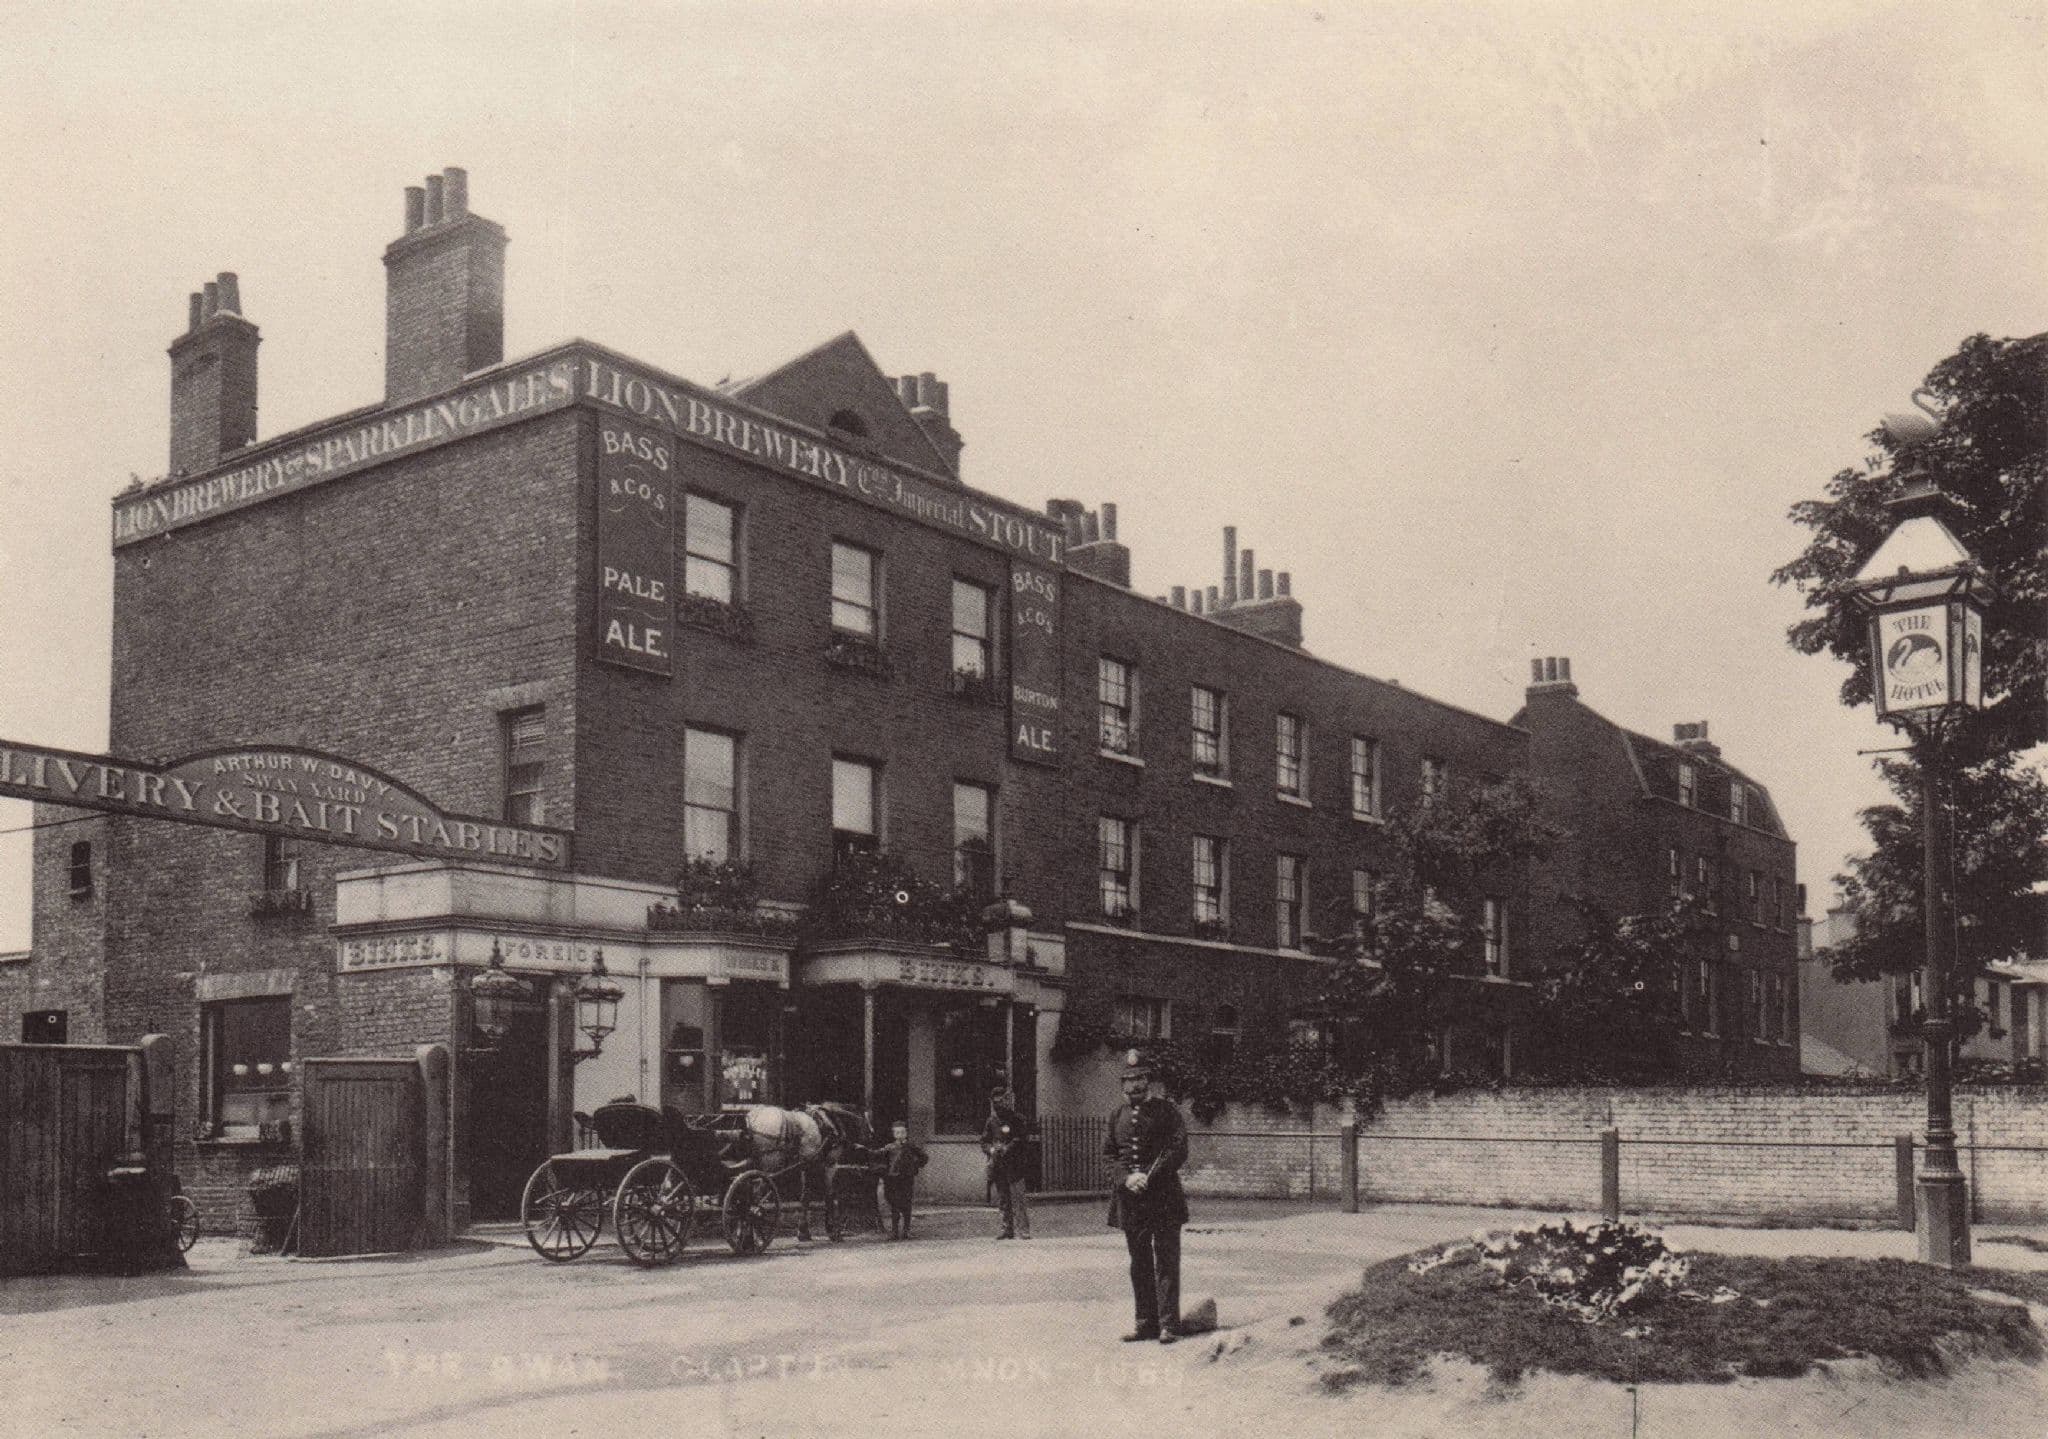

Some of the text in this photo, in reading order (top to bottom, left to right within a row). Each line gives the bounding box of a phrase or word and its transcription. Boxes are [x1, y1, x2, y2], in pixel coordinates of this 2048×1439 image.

[114, 487, 170, 540] LION
[173, 457, 286, 521] BREWERY
[305, 396, 483, 474] SPARKLING
[484, 362, 570, 419] ALES
[587, 361, 683, 427] LION
[688, 405, 853, 488] BREWERY
[889, 474, 965, 531] Imperial
[603, 431, 668, 470] BASS
[604, 567, 665, 601] PALE
[1012, 572, 1056, 602] BASS
[1892, 615, 1931, 633] THE
[1013, 685, 1058, 709] BURTON
[1891, 679, 1944, 700] HOTEL
[213, 755, 292, 774] ARTHUR
[243, 772, 366, 804] SWAN YARD
[1, 748, 560, 862] LIVERY & BAIT STABLES
